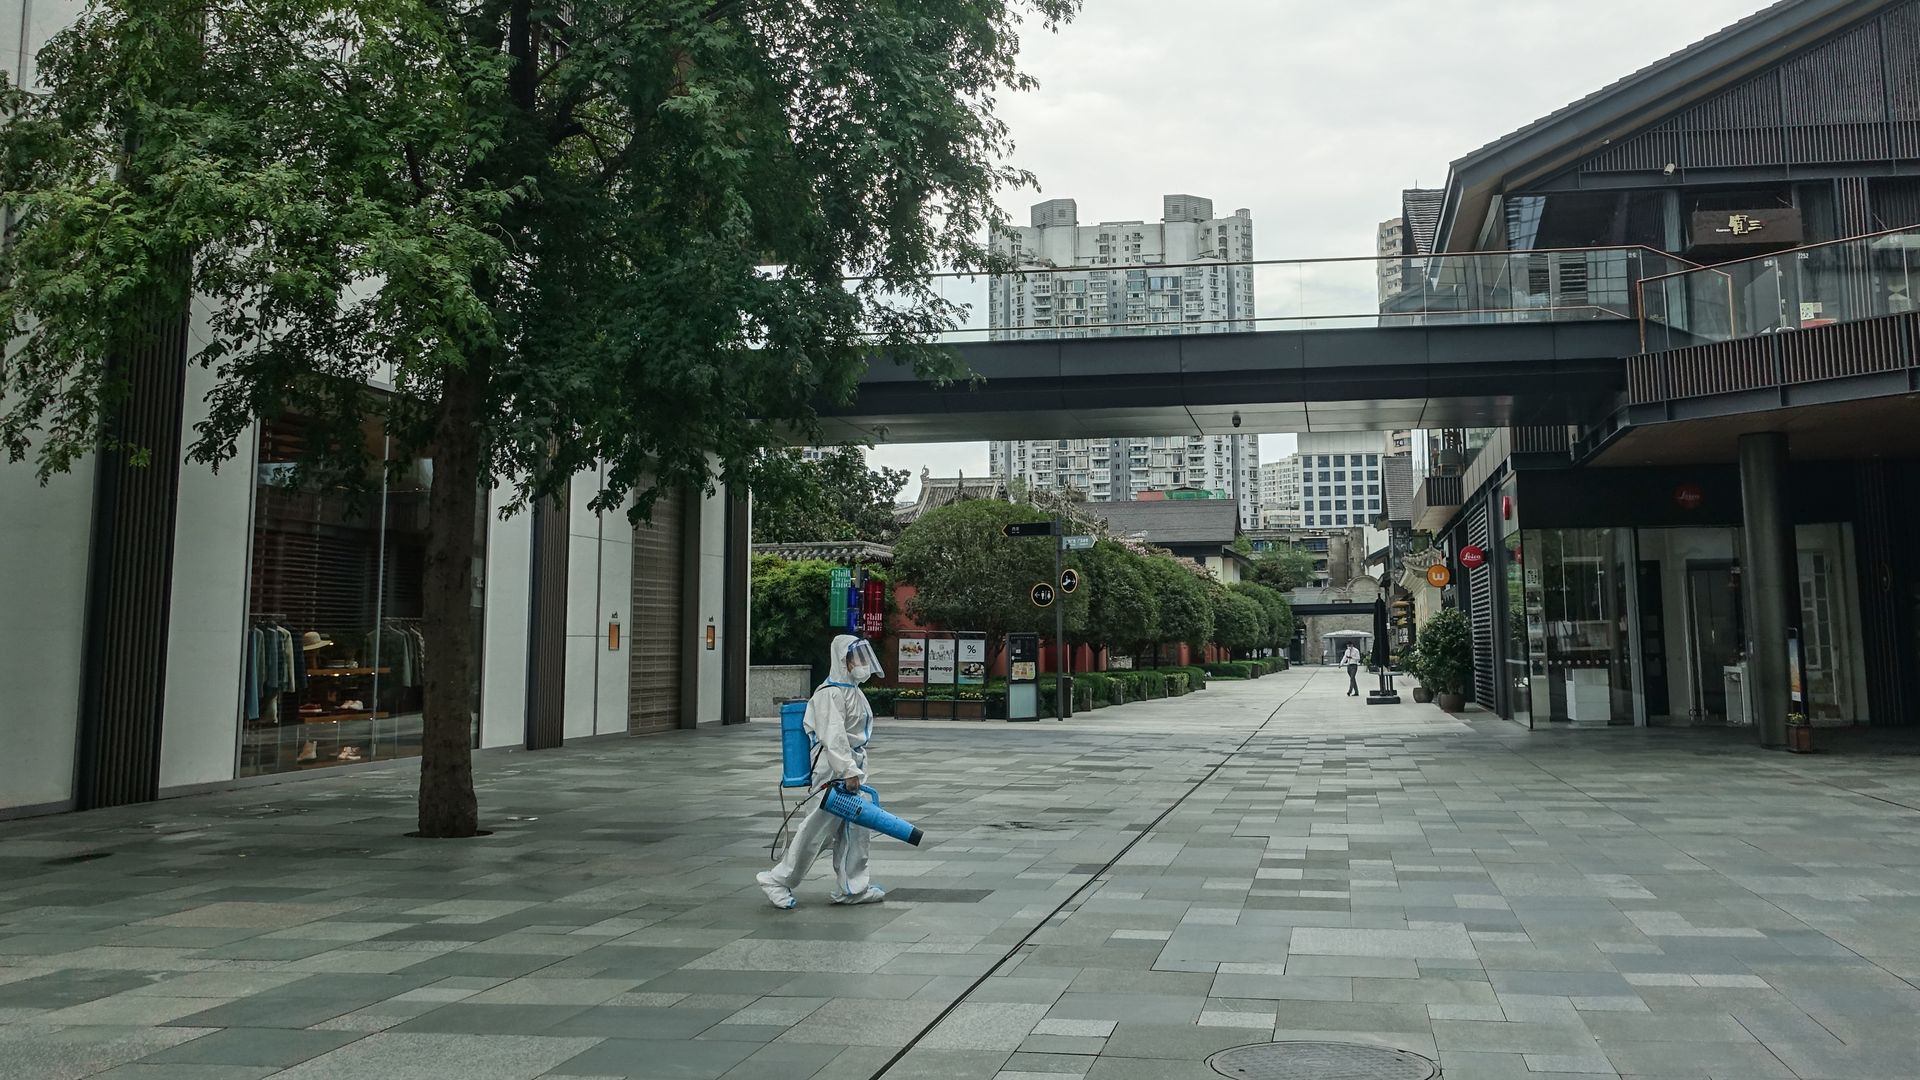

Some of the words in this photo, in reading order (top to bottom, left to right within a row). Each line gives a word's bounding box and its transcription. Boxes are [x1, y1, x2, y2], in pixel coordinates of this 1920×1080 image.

[1463, 552, 1481, 561] Leica
[863, 623, 882, 631] Lane
[967, 644, 977, 654] %
